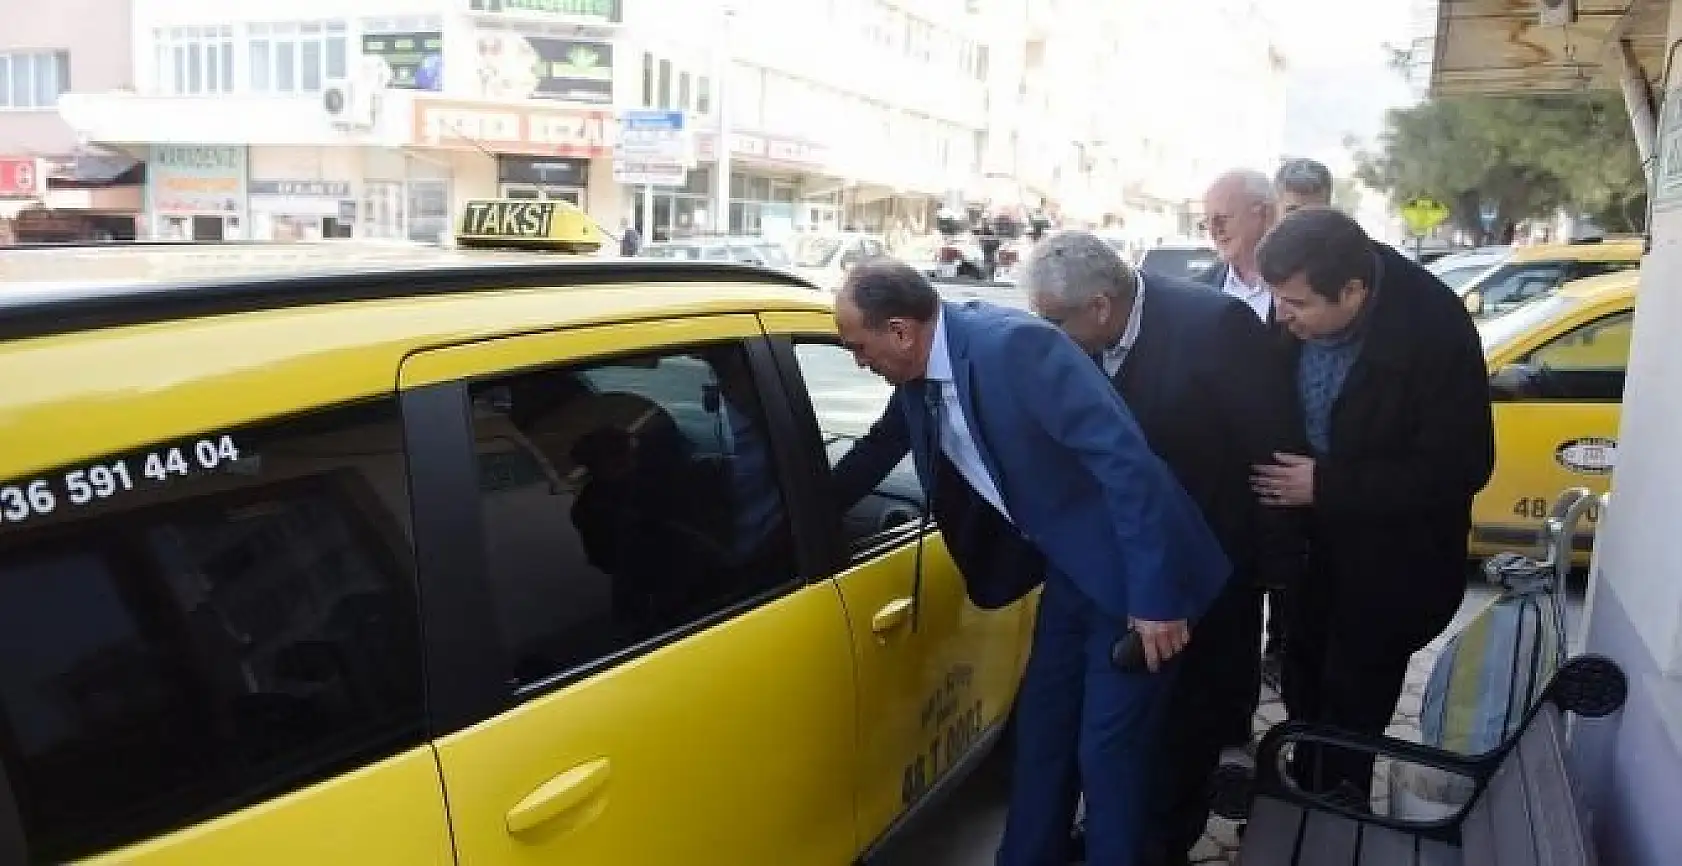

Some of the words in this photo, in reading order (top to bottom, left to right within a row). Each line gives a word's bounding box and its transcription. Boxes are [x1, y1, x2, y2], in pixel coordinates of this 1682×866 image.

[468, 202, 554, 237] TAKSİ
[0, 479, 56, 522] 36
[66, 460, 133, 504] 591
[144, 447, 188, 480] 44
[195, 435, 240, 469] 04
[1514, 497, 1546, 518] 48
